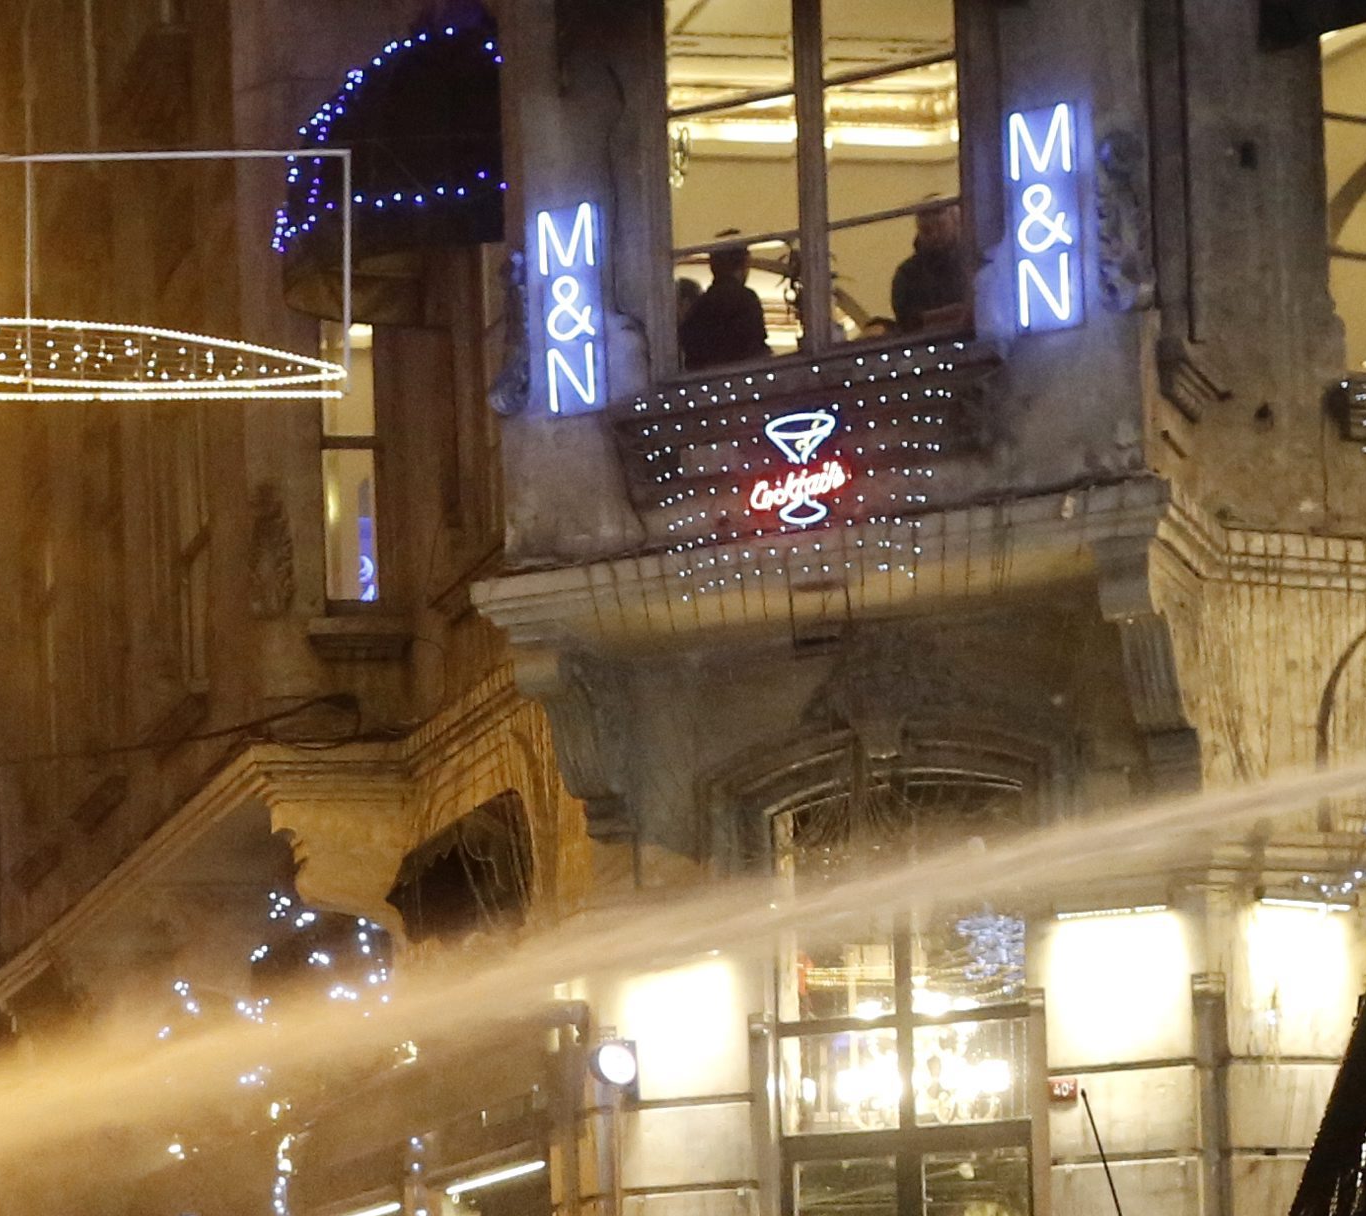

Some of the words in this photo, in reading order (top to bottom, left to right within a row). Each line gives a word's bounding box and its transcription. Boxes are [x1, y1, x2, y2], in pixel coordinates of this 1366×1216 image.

[537, 202, 595, 413] M&N
[1009, 103, 1072, 328] M&N
[750, 461, 846, 510] Cocktails
